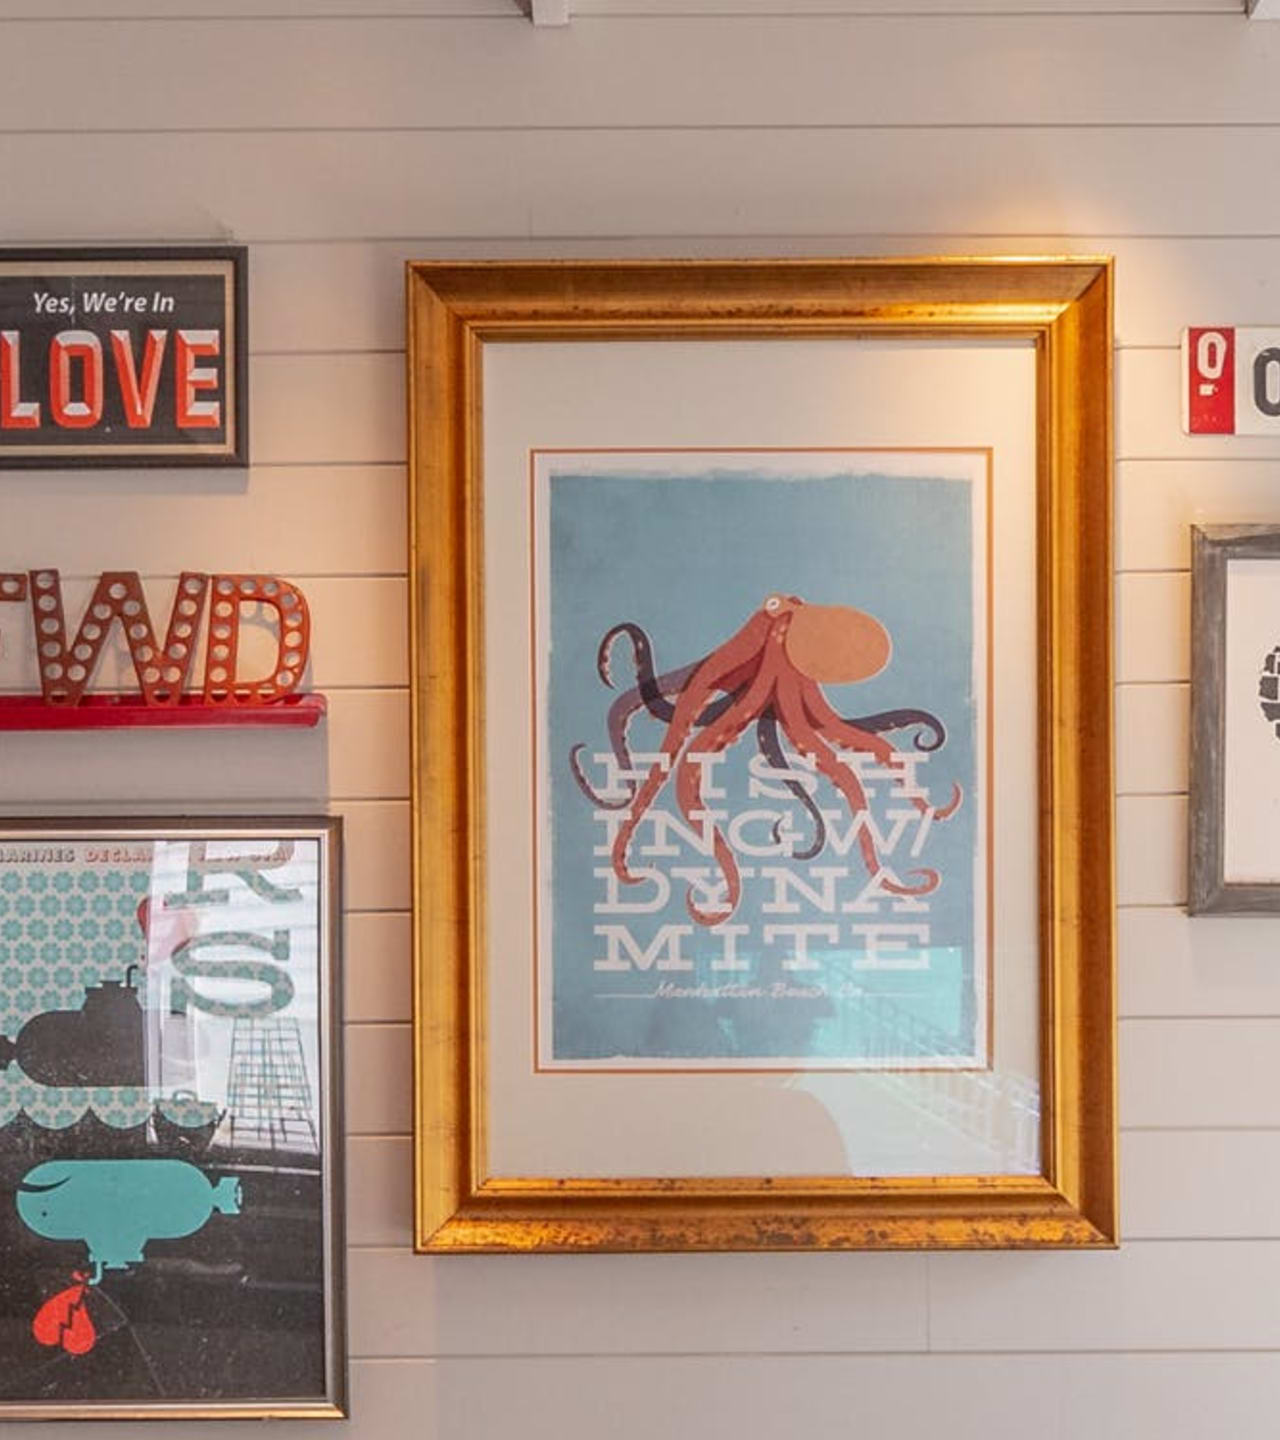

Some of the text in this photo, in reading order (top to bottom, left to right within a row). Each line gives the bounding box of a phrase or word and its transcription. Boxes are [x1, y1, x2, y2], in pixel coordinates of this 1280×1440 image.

[33, 292, 76, 315] Yes,
[152, 292, 175, 313] In
[594, 752, 931, 799] FISH
[594, 866, 931, 914] DYNA
[594, 923, 931, 971] MITE
